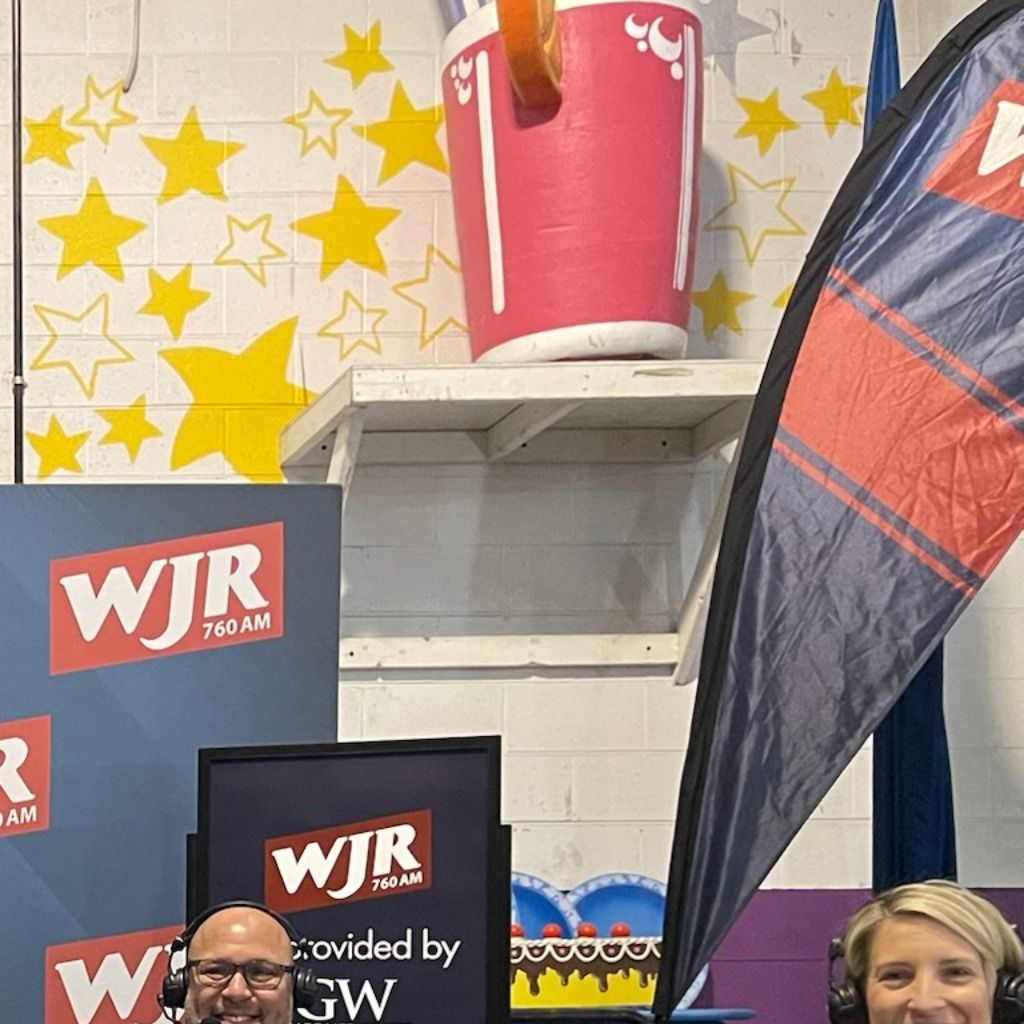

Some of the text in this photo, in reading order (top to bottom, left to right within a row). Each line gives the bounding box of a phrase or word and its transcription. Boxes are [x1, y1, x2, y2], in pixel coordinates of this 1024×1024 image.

[59, 543, 270, 651] WJR
[202, 612, 271, 640] 760 AM
[6, 805, 37, 826] AM
[271, 823, 422, 900] WJR
[372, 871, 423, 892] 760 AM
[422, 928, 462, 969] by
